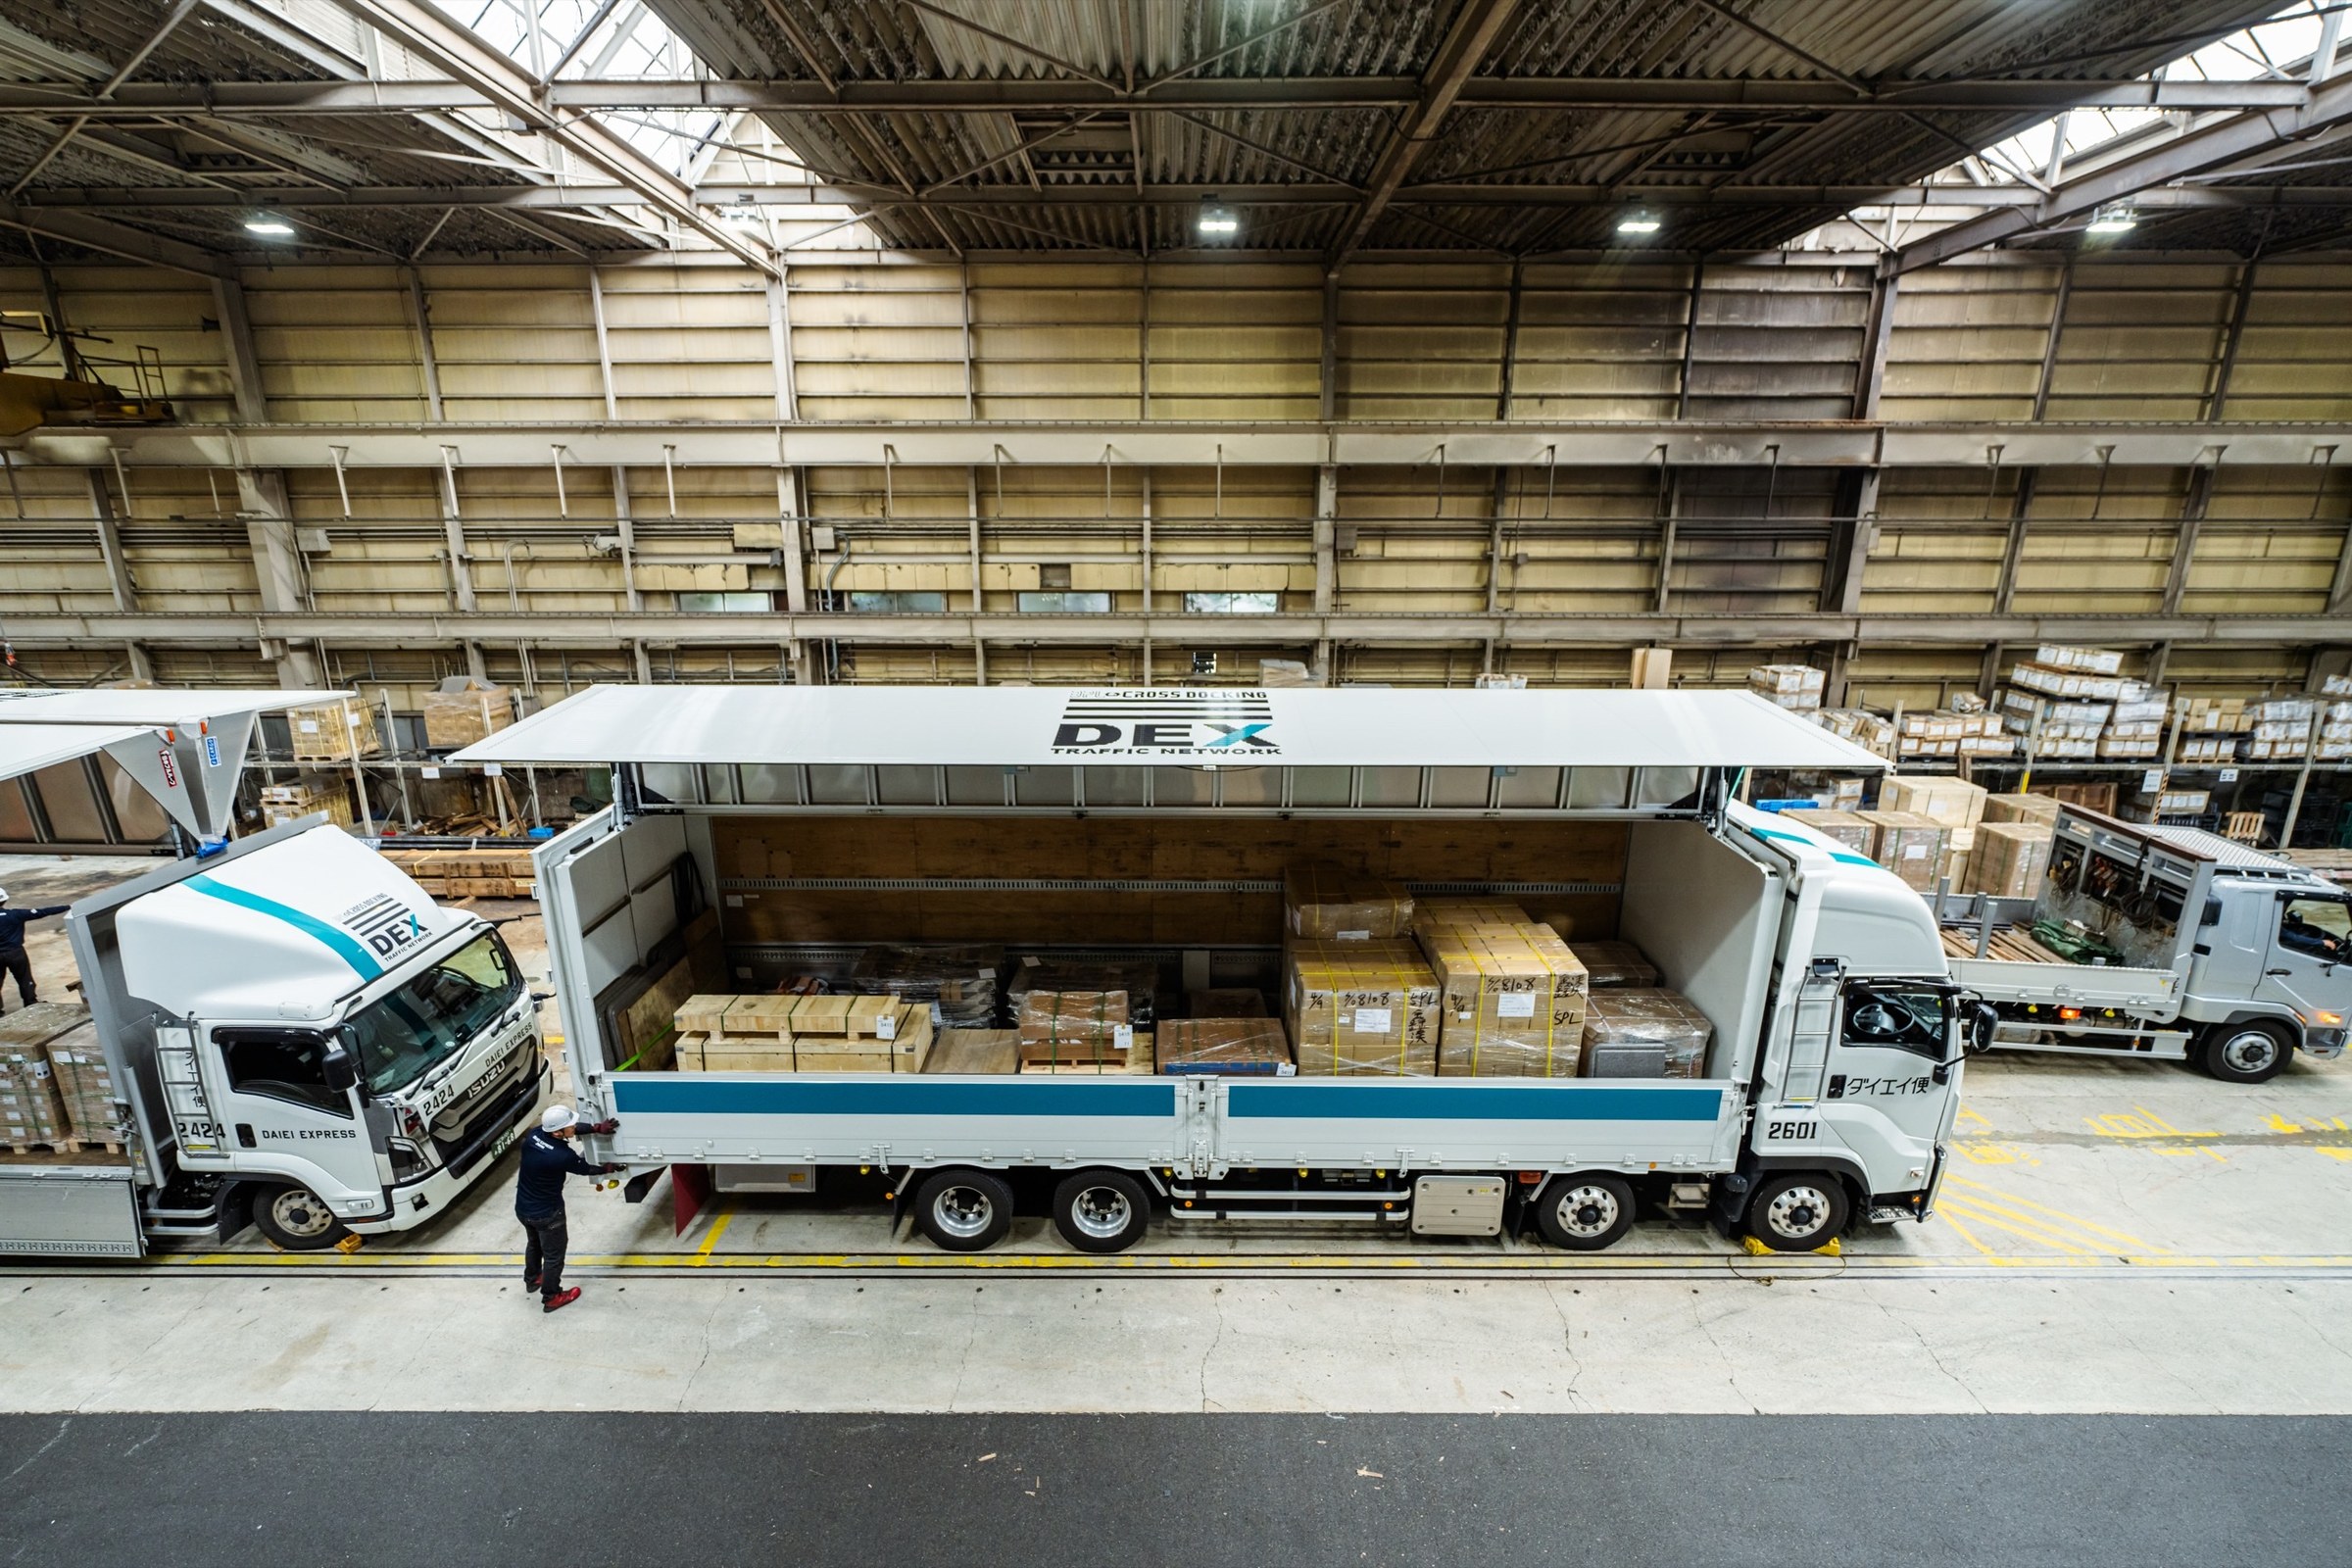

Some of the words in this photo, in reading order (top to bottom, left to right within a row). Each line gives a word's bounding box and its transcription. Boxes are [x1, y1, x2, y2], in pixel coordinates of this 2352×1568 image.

[1053, 723, 1280, 747] DEX
[367, 913, 428, 956] DEX
[384, 947, 408, 962] TRAFFIC
[408, 931, 433, 949] NETWORK
[485, 1048, 504, 1067] DAIEI
[506, 1021, 533, 1051] EXPRESS
[466, 1060, 507, 1099] ISUZU
[1846, 1076, 1931, 1096] ダイエイ便
[423, 1084, 455, 1117] 2424
[178, 1122, 226, 1139] 2424
[263, 1130, 294, 1139] DAIEI
[300, 1129, 357, 1139] EXPRESS
[1768, 1121, 1817, 1139] 2601
